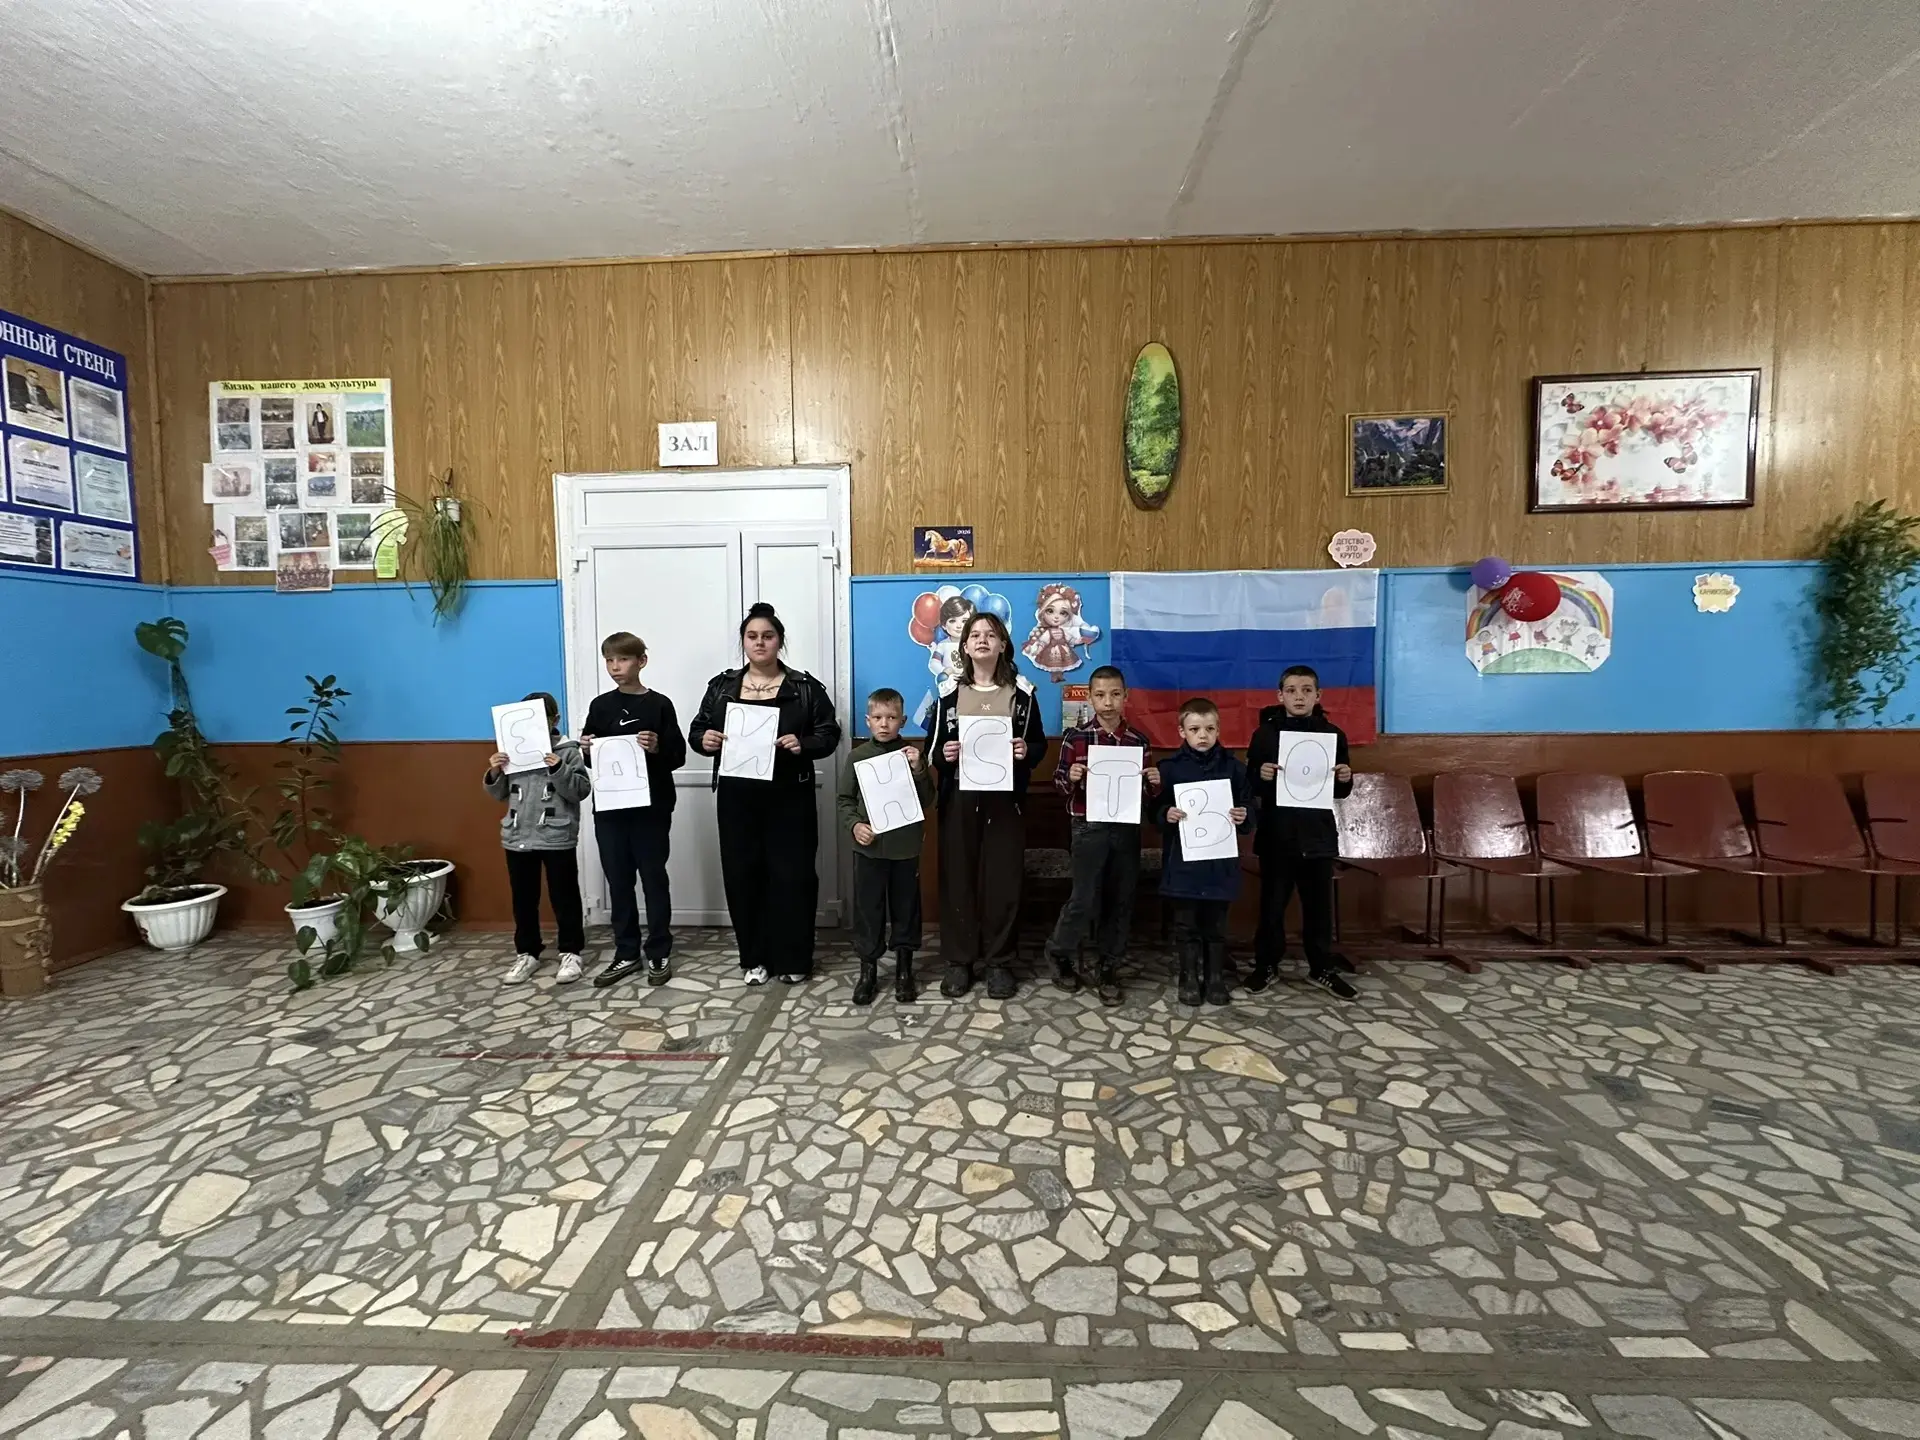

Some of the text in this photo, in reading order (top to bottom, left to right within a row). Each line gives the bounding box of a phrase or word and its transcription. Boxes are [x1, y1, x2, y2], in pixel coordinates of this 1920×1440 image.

[0, 320, 117, 383] ННЫЙ СТЕНД
[221, 379, 377, 391] Жизнь нашего дома культуры
[668, 435, 709, 452] ЗАЛ
[593, 738, 648, 793] Д
[722, 706, 778, 777] И
[856, 753, 919, 832] Н
[1089, 759, 1141, 818] Т
